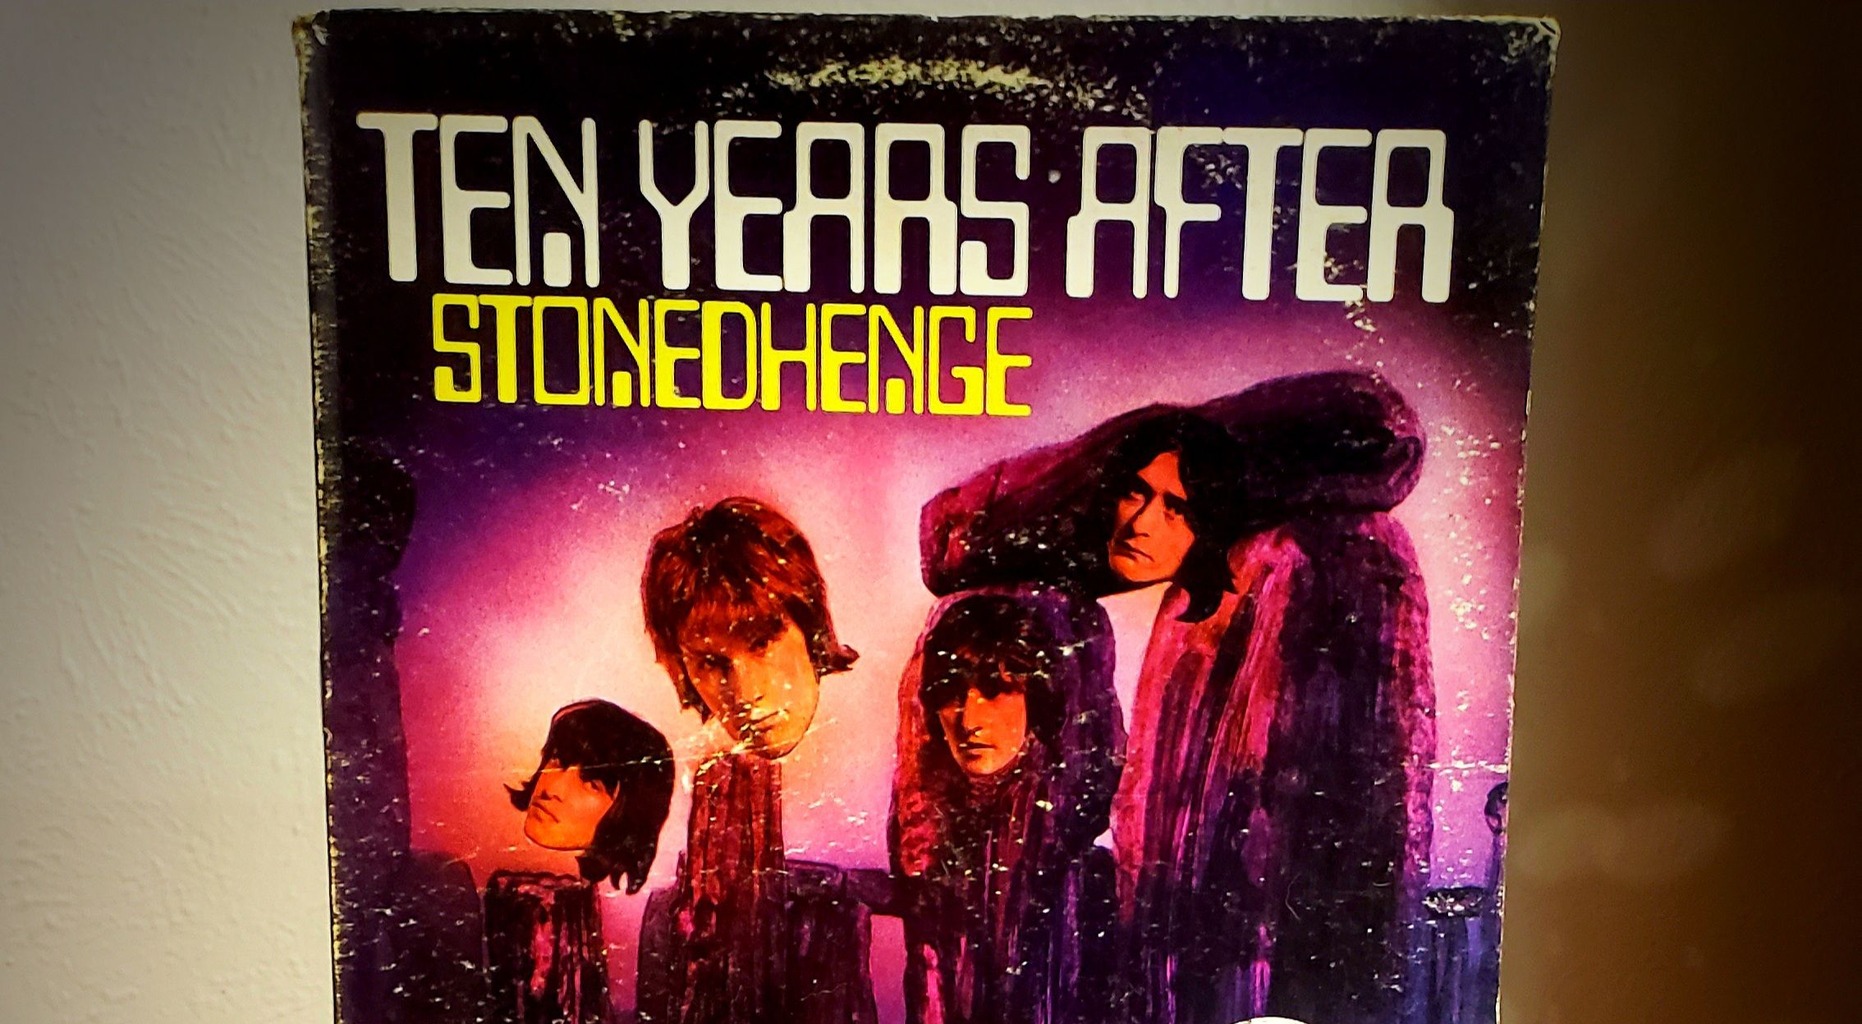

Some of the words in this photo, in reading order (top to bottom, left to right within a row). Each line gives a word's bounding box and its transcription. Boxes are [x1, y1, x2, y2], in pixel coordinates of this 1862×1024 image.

[356, 112, 600, 288] TEN
[638, 119, 1029, 296] YEARS
[1066, 126, 1455, 303] AFTER
[432, 294, 1033, 417] STONEDHENGE
